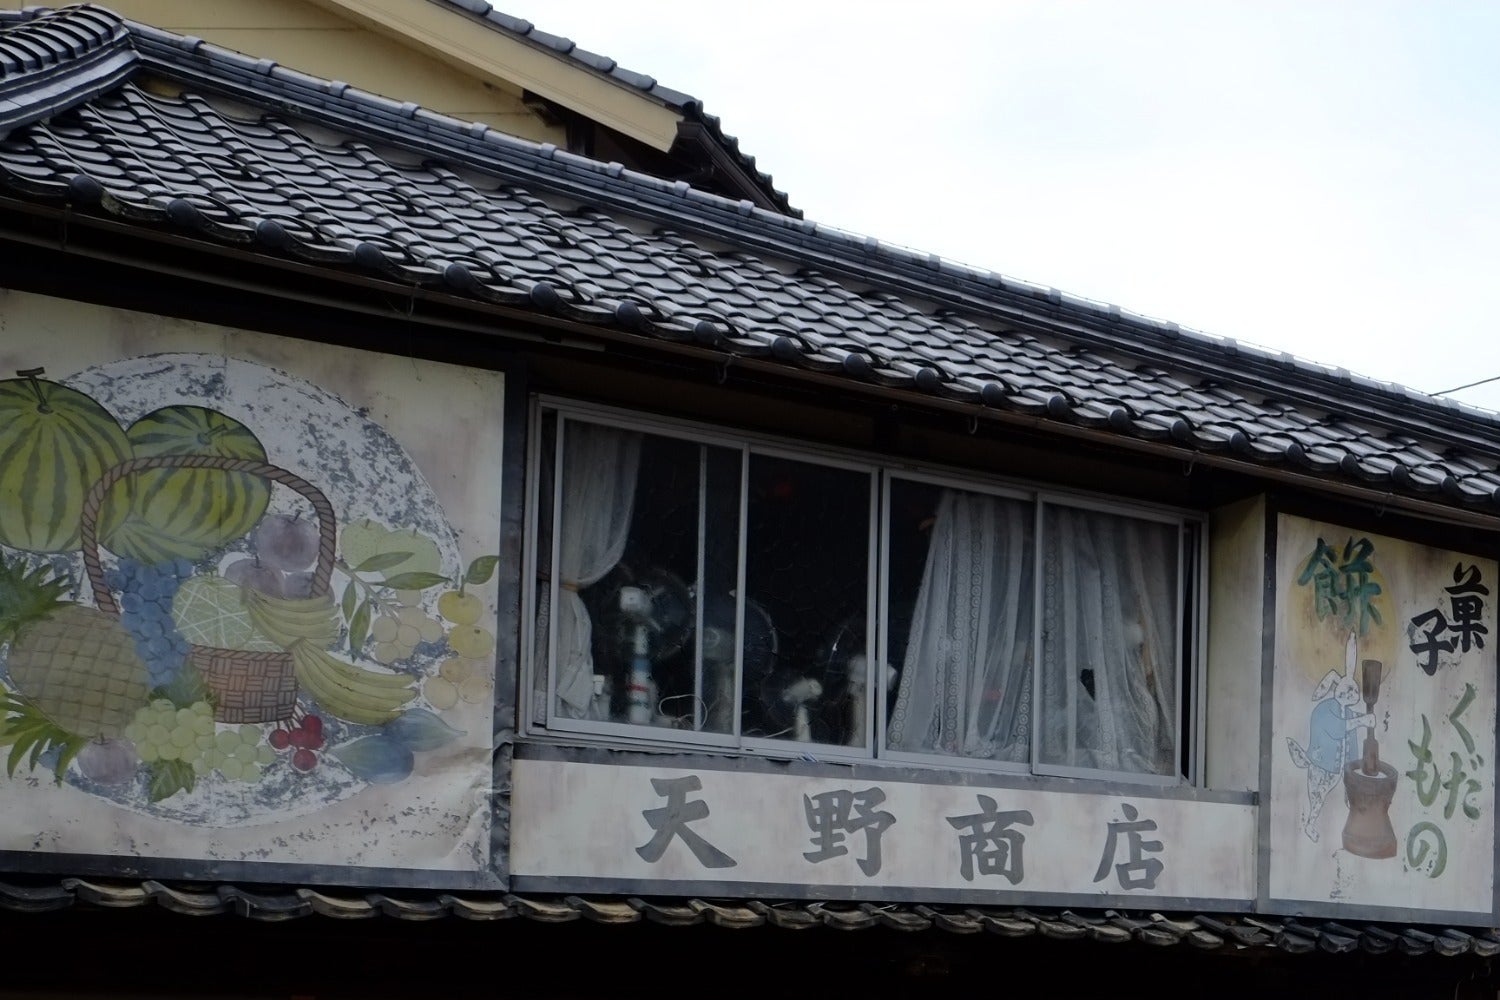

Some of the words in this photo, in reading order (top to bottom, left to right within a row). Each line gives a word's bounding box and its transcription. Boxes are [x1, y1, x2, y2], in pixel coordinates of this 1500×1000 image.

[1298, 535, 1384, 638] 餅
[1410, 561, 1490, 677] 菓子
[635, 774, 1164, 892] 天野商店
[1404, 682, 1485, 879] くだもの
